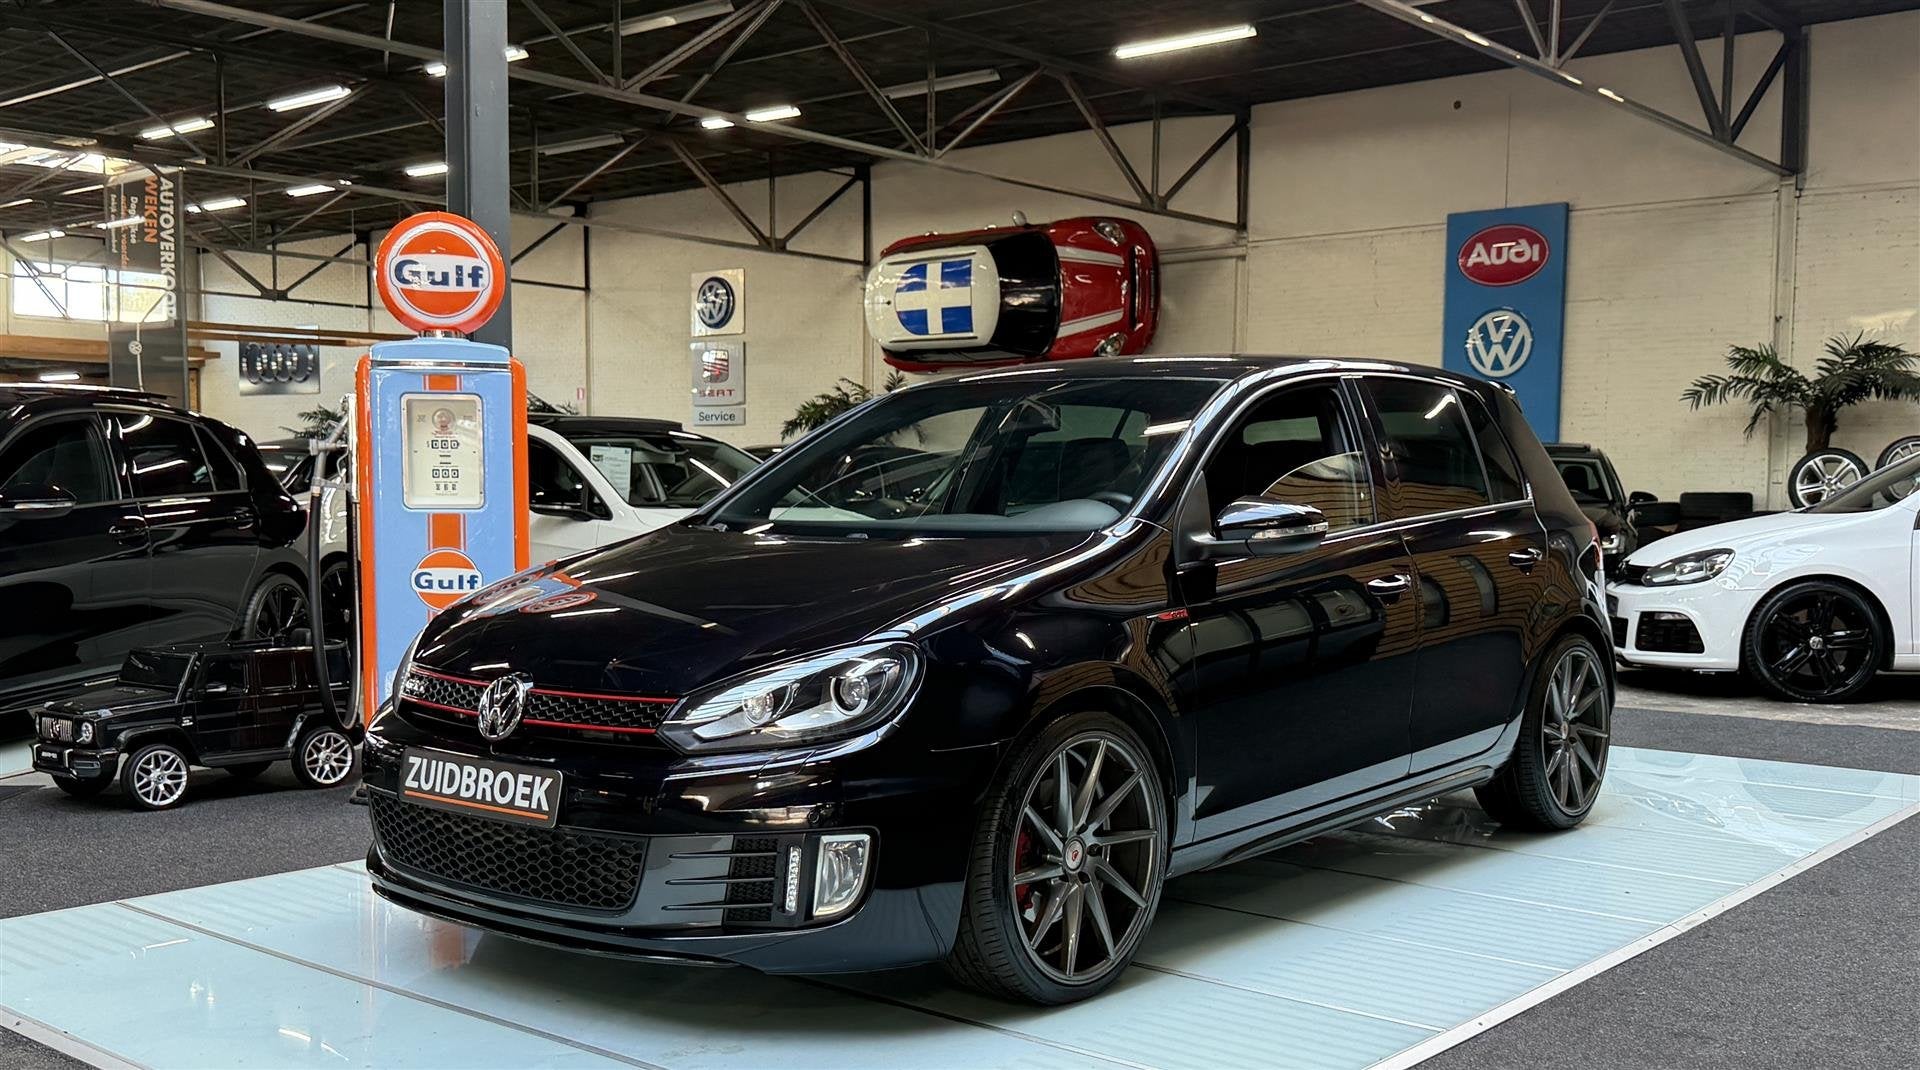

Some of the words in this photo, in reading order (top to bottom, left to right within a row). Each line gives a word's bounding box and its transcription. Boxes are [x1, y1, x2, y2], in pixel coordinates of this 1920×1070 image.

[144, 175, 159, 245] WEKEN
[394, 259, 484, 288] Gulf
[698, 411, 736, 422] Service
[414, 571, 479, 590] Gulf
[404, 756, 554, 812] ZUIDBROEK
